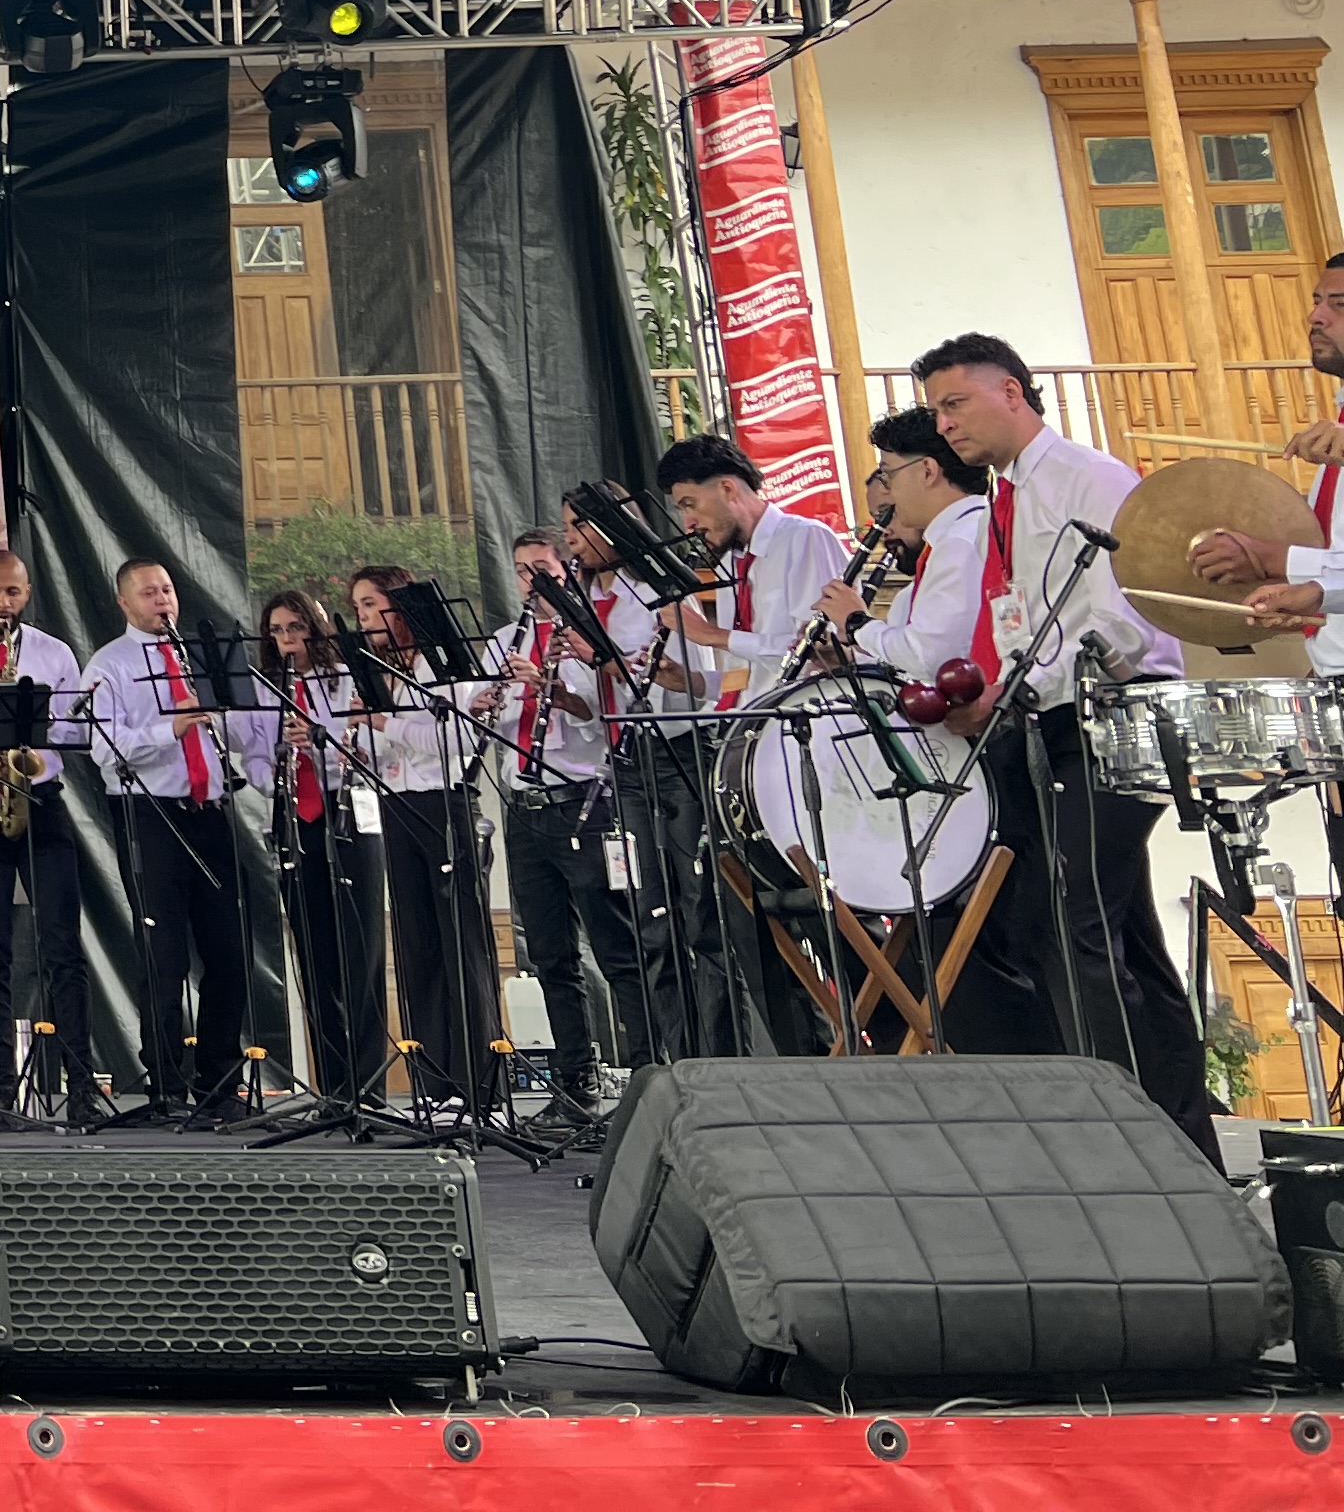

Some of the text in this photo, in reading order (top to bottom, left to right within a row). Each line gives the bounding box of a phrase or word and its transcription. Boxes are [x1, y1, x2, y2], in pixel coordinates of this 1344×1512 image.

[705, 114, 771, 146] Aguardiente
[705, 124, 773, 158] Antioqueño
[714, 198, 785, 230] Aguardiente
[714, 208, 788, 242] Antioqueño
[727, 283, 798, 315] Aguardiente
[727, 294, 800, 328] Antioqueño
[740, 369, 813, 403] Aguardiente
[740, 381, 816, 414] Antioqueño
